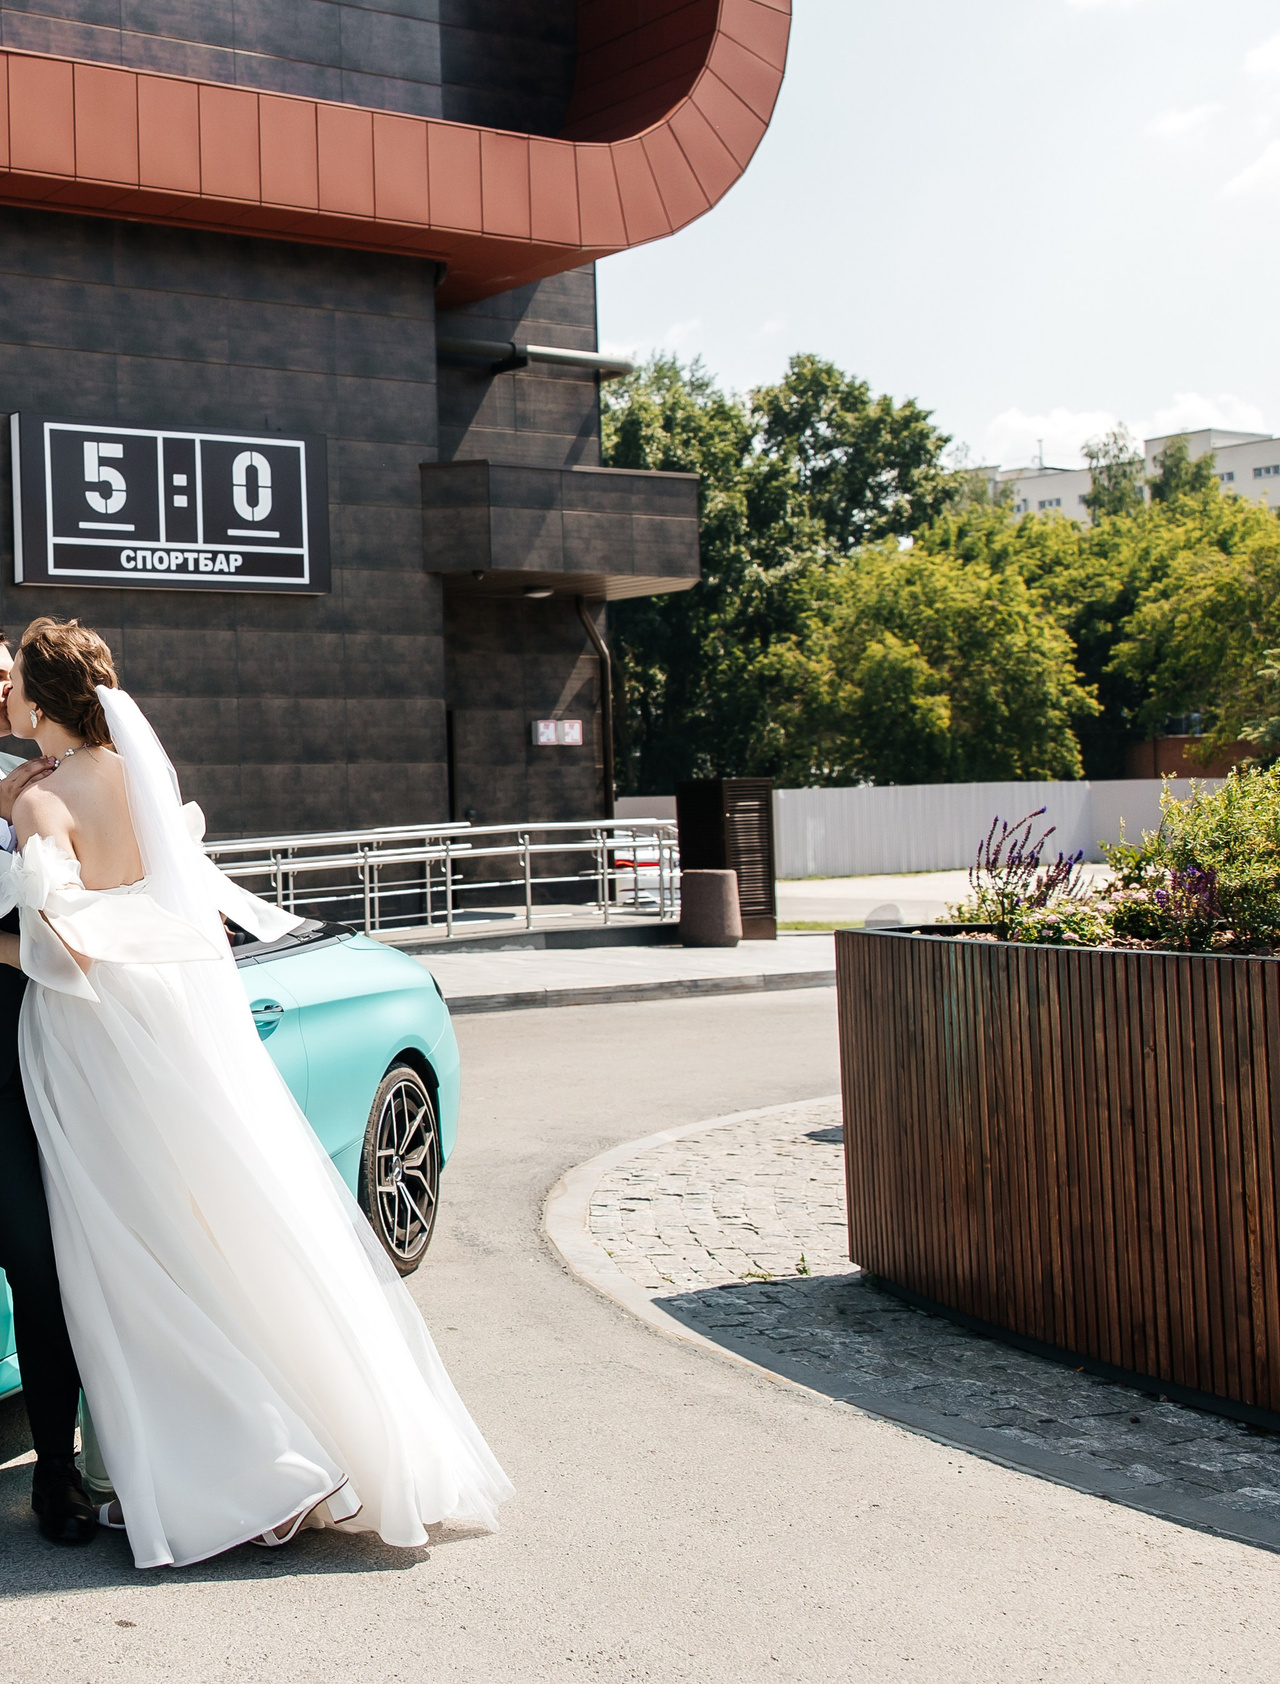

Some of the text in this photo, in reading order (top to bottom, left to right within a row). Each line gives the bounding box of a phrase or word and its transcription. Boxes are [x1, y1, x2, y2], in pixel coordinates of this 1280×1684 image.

[83, 441, 127, 514] 5
[232, 450, 272, 522] 0
[120, 549, 243, 573] СПОРТБАР
